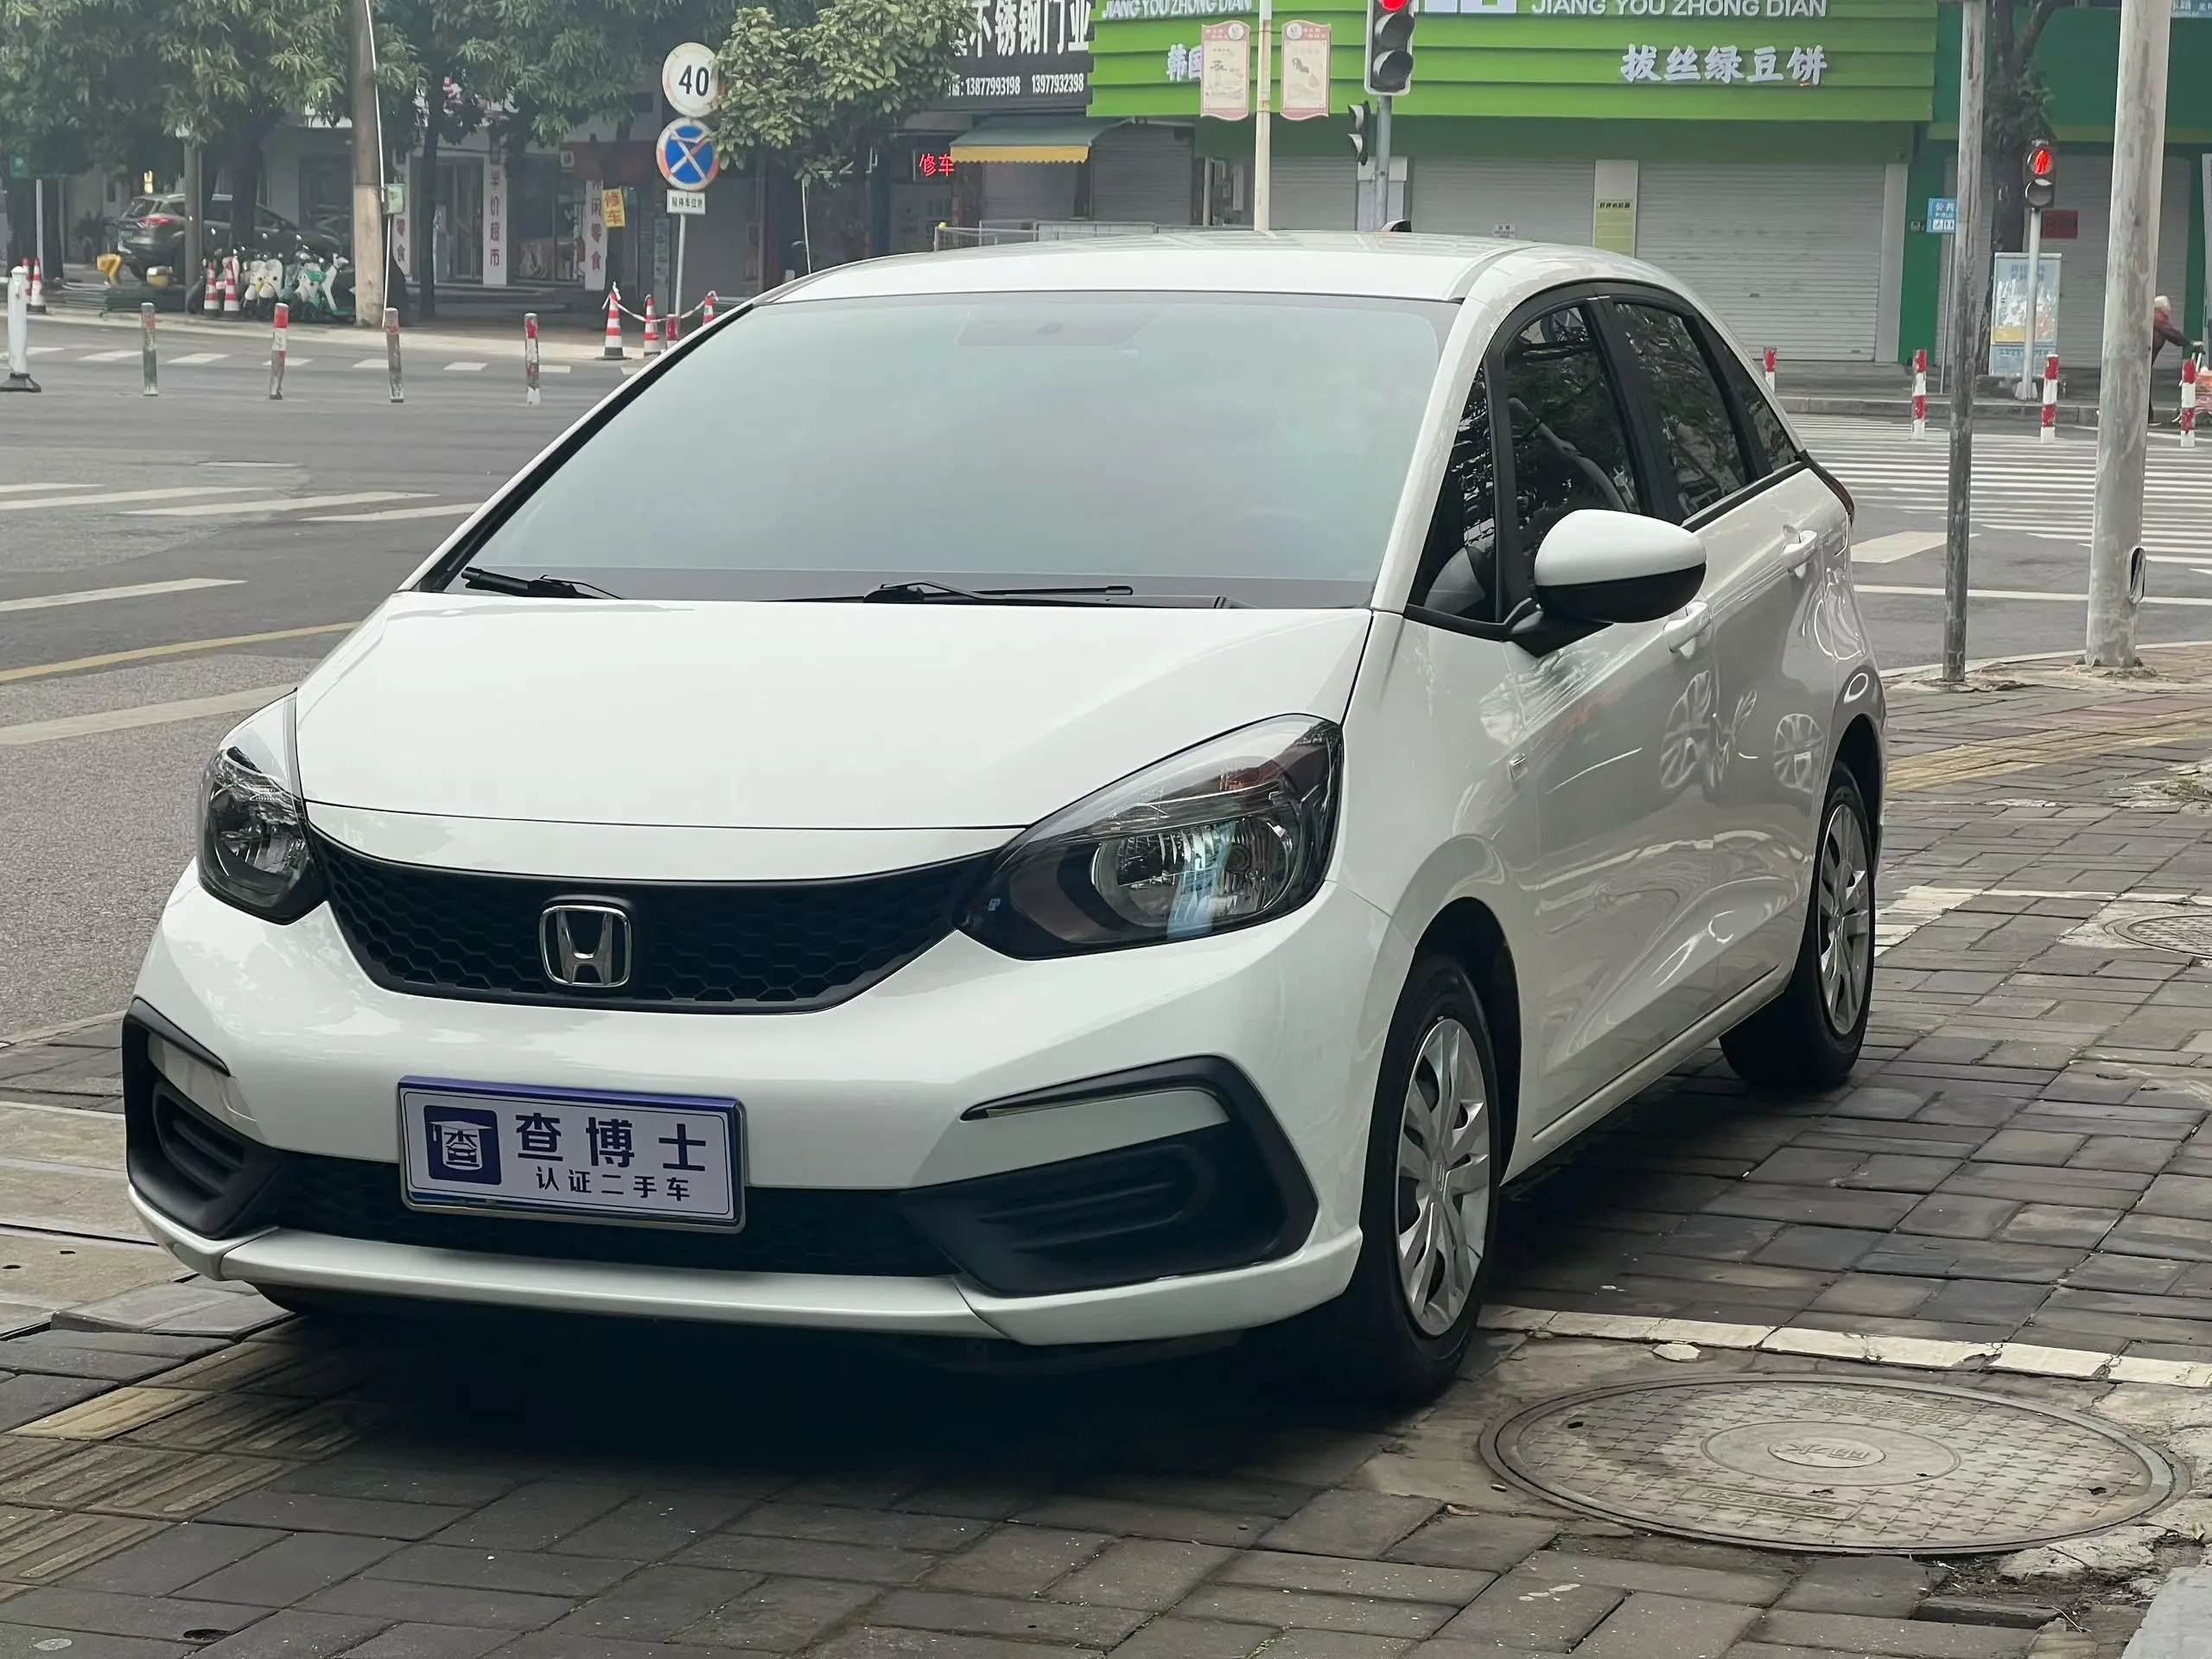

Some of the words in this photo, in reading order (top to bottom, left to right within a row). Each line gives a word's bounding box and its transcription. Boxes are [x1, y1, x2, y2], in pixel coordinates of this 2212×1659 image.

[1531, 0, 1606, 15] JIANG
[1615, 0, 1666, 16] YOU
[1671, 0, 1760, 16] ZHONG
[1766, 0, 1827, 17] DIAN
[678, 64, 709, 97] 40
[1620, 43, 1827, 86] 拔丝绿豆饼
[1031, 73, 1084, 94] 13977932398
[918, 153, 955, 177] 修车
[606, 190, 623, 226] 修车
[515, 1112, 707, 1173] 查博士
[536, 1166, 690, 1202] 认证二手车
